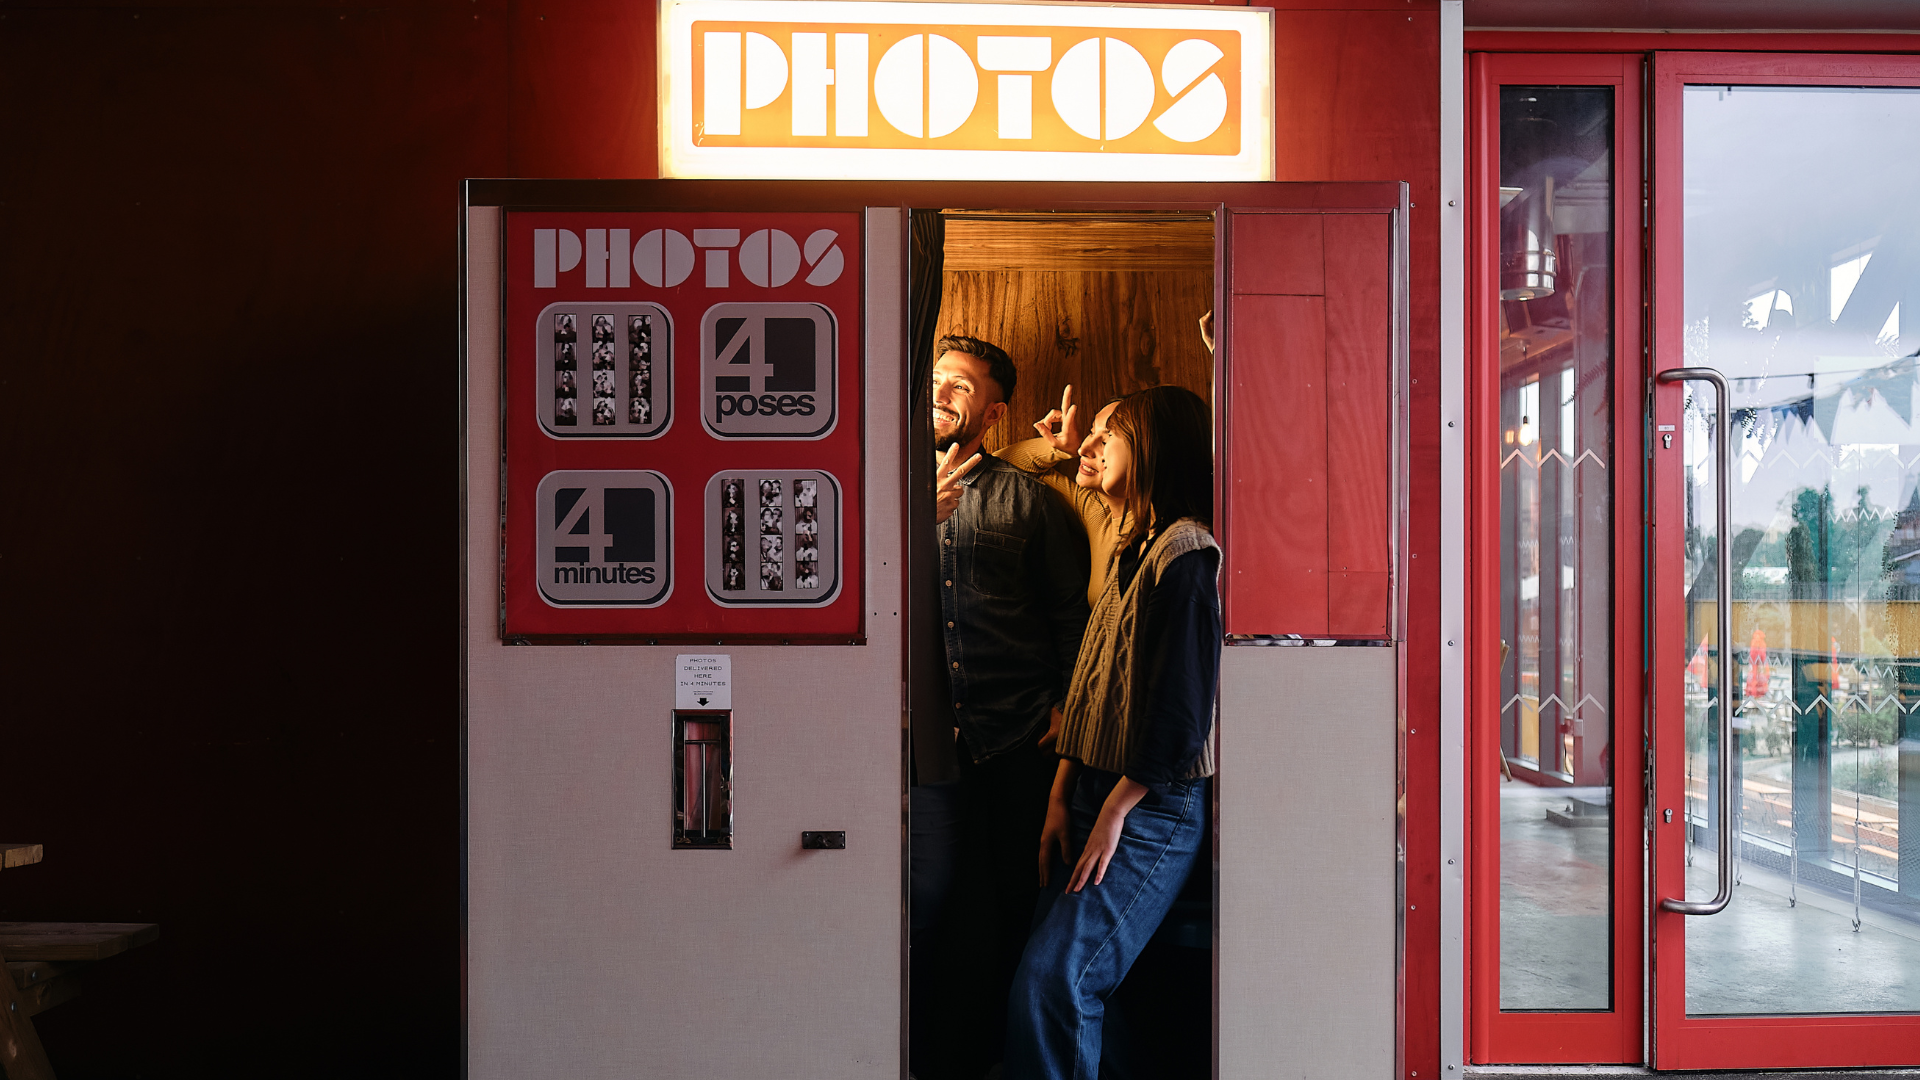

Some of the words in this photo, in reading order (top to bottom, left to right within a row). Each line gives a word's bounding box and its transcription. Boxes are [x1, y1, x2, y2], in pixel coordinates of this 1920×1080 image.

[703, 31, 1228, 143] PHOTOS
[534, 228, 845, 288] PHOTOS
[715, 316, 774, 392] 4
[715, 393, 816, 424] poses
[554, 487, 613, 562] 4
[554, 561, 656, 585] minutes
